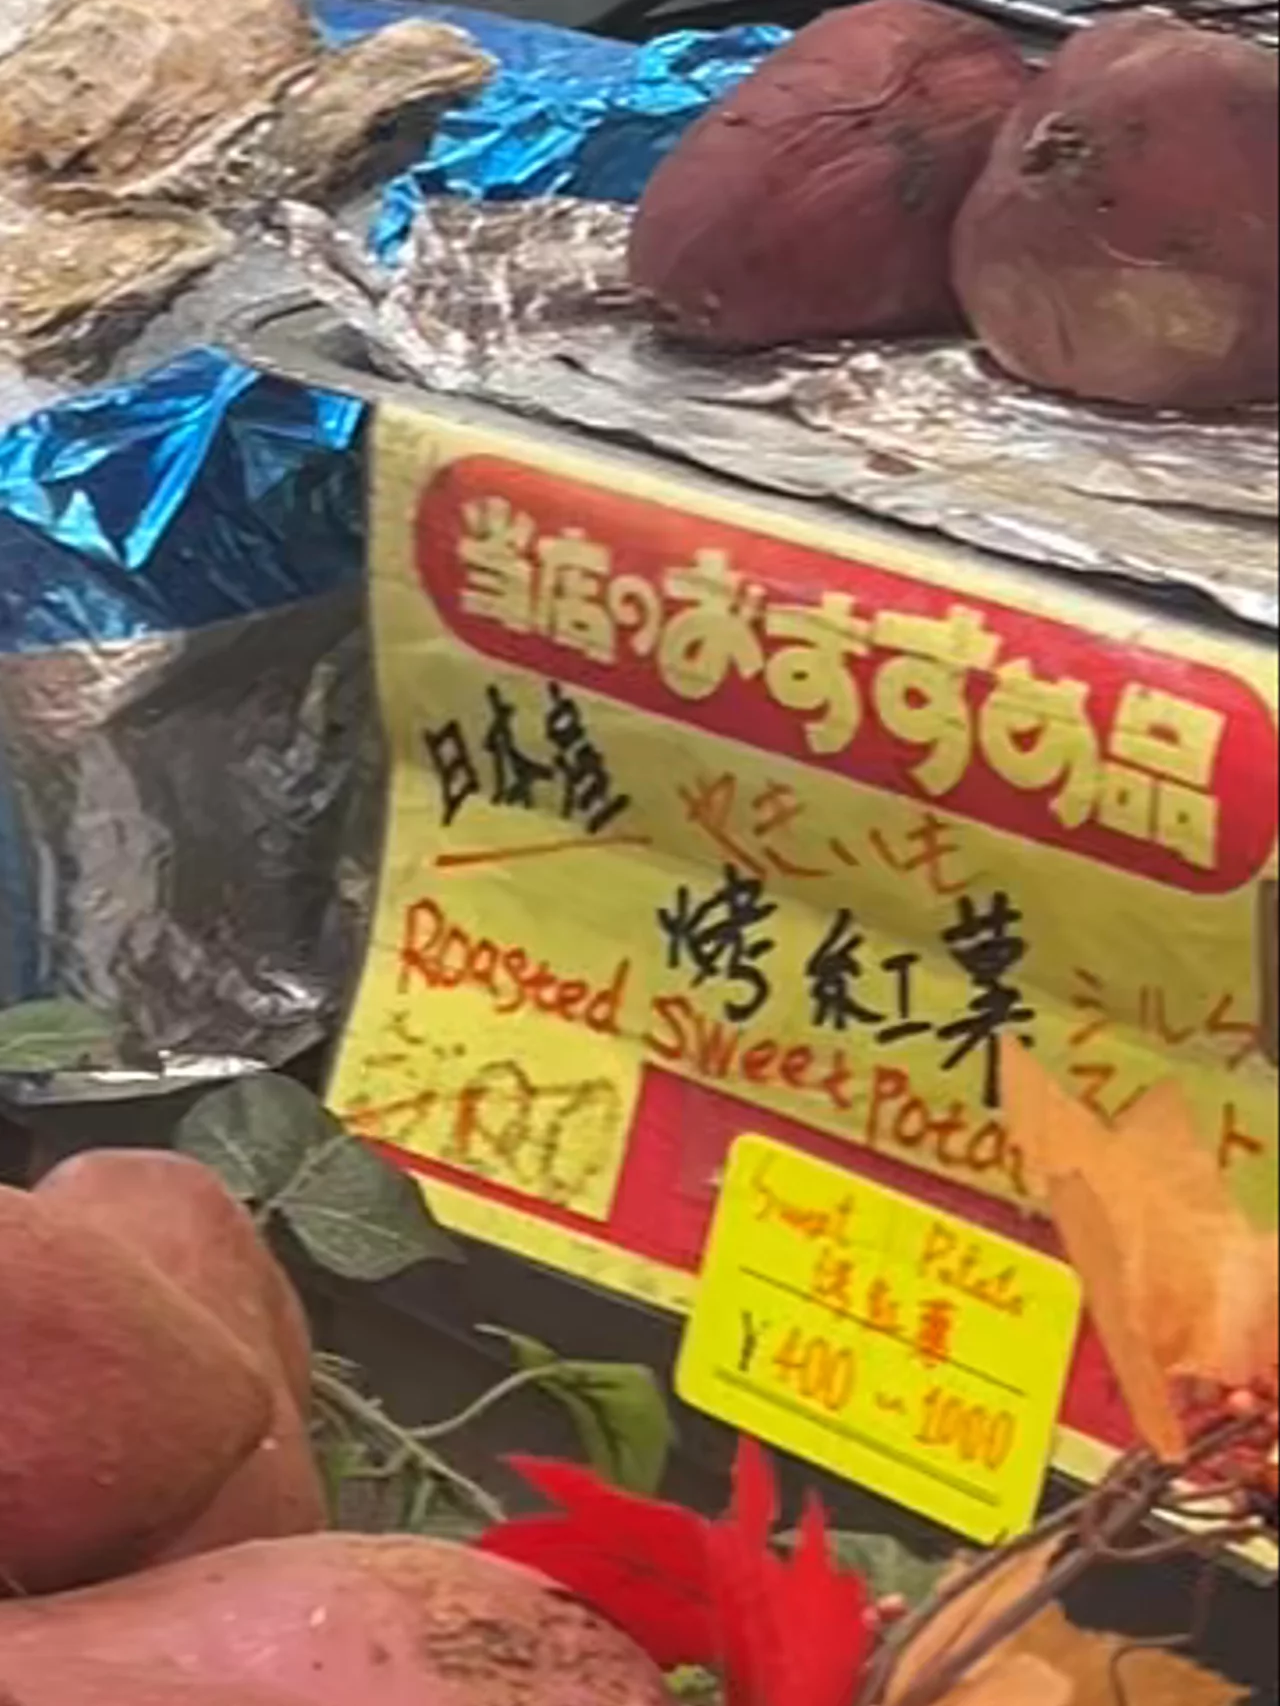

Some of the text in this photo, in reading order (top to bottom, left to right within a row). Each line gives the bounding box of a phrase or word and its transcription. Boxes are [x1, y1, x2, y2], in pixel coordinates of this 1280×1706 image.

[458, 496, 1226, 869] 当店のおすすめ品
[870, 1064, 1030, 1201] Pota
